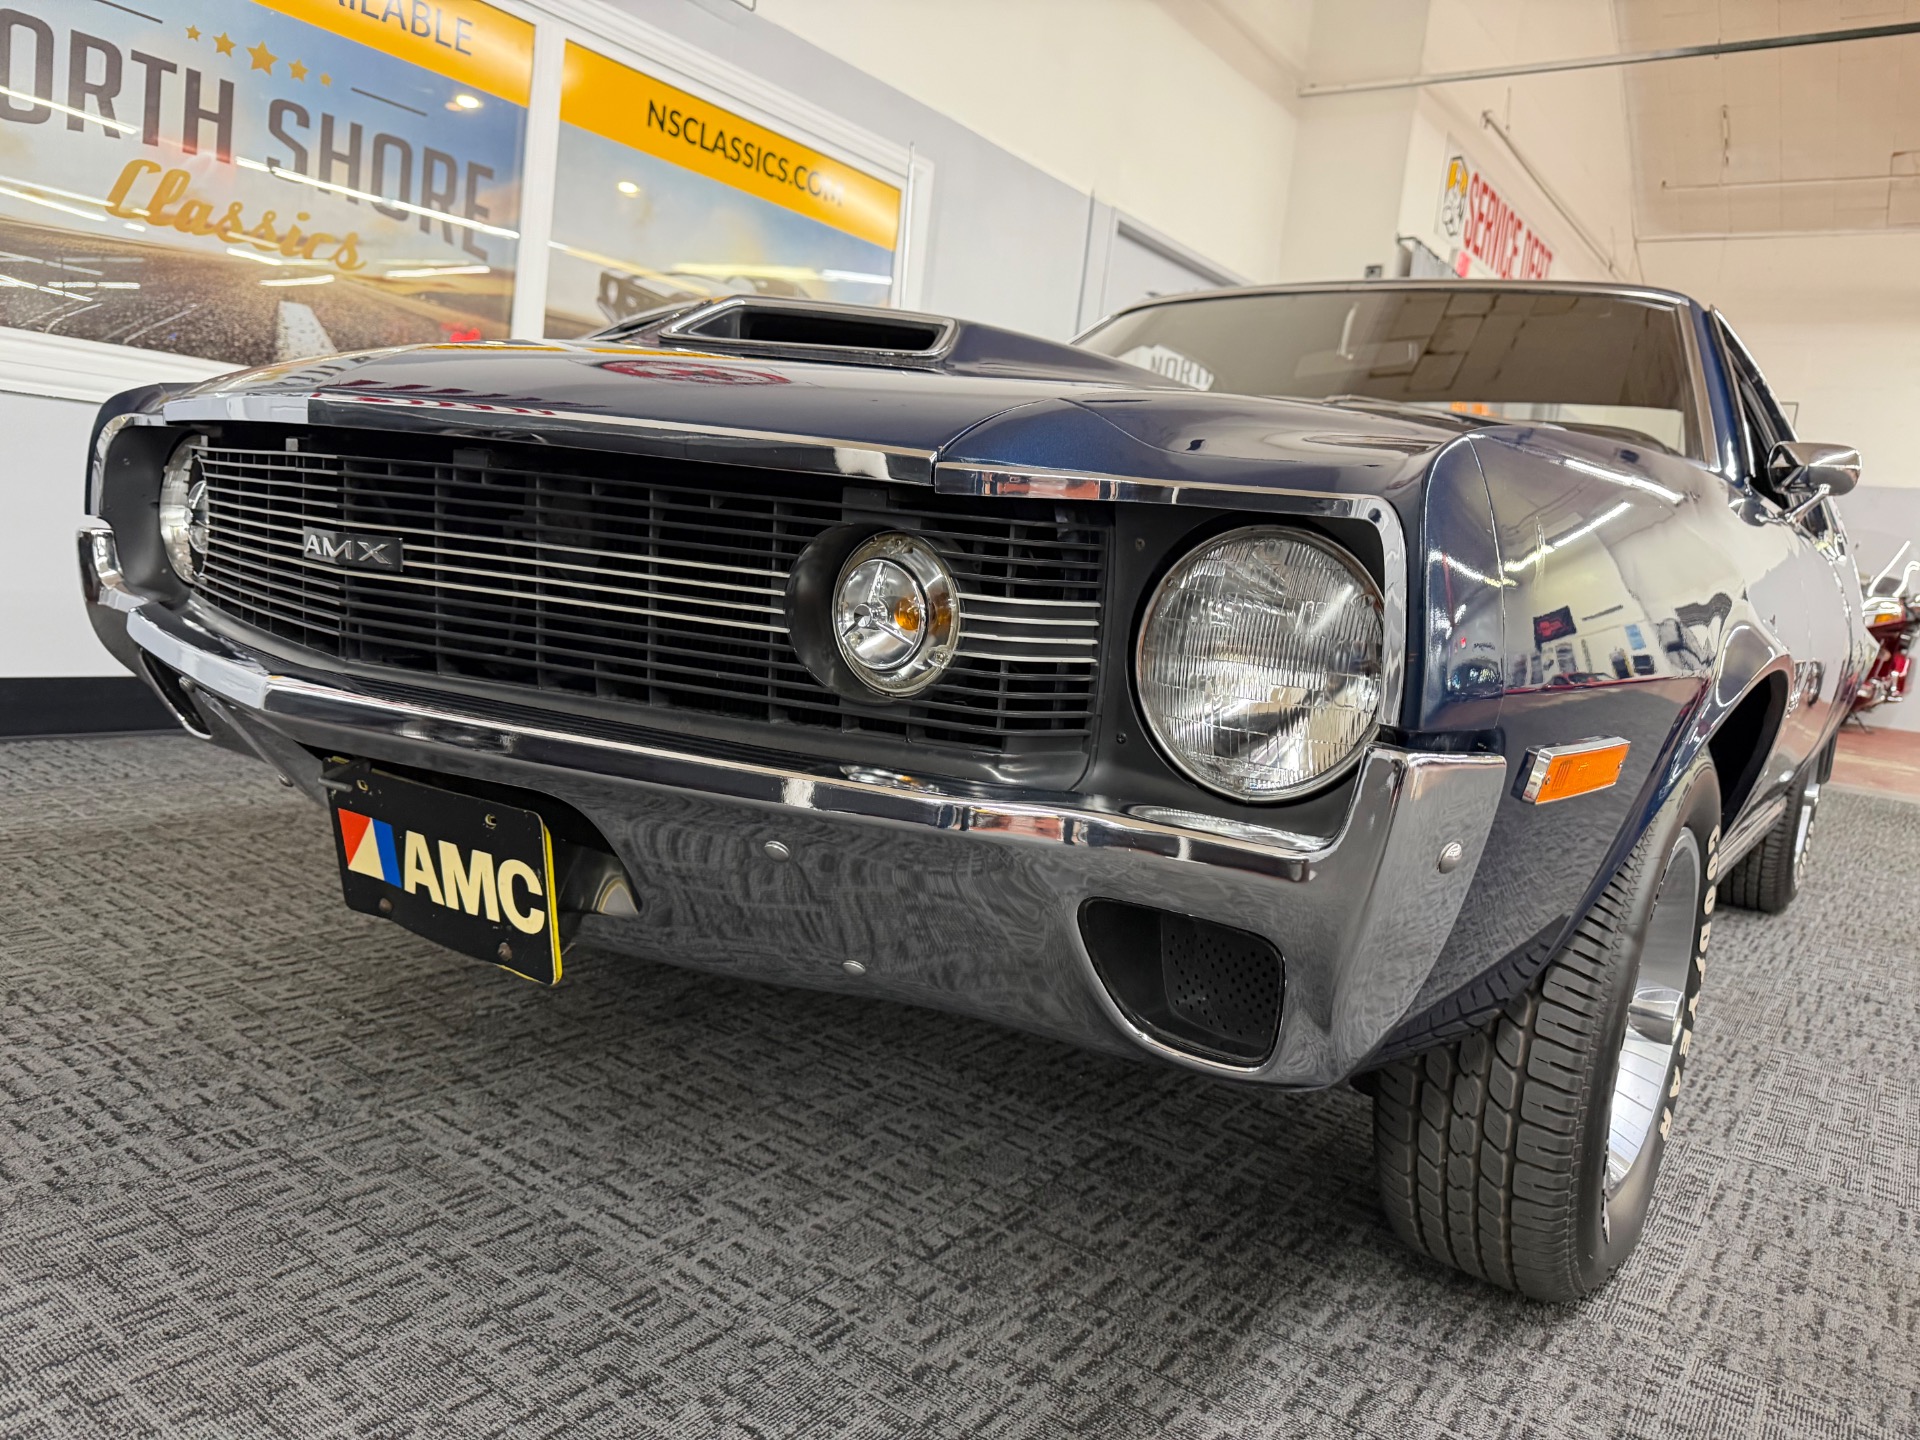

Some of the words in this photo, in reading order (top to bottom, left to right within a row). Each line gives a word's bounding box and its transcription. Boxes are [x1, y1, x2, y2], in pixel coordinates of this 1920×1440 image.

[104, 159, 367, 271] Classics
[266, 98, 495, 261] SHORE
[1463, 171, 1522, 279] SERVICE
[305, 534, 393, 565] AMX
[404, 830, 546, 935] AMC
[1657, 824, 1720, 1142] GOODYEAR
